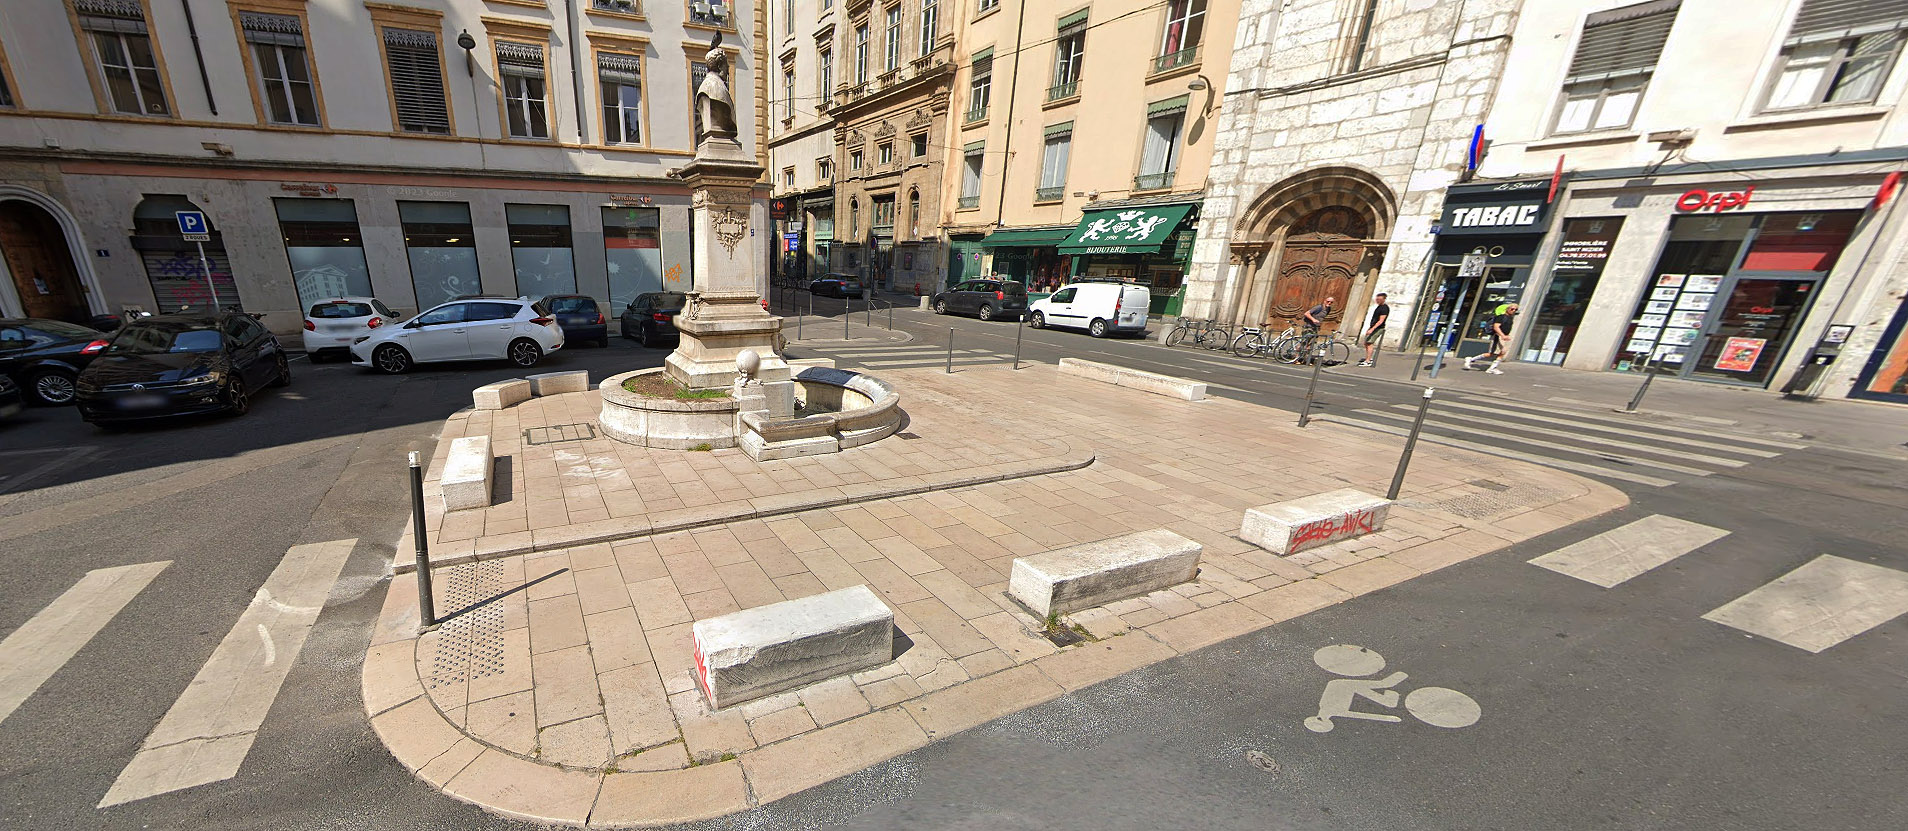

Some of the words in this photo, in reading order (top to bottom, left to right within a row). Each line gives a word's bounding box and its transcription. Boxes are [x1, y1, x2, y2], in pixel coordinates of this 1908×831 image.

[1676, 185, 1757, 213] Orpi
[184, 215, 197, 230] P
[1452, 204, 1540, 227] TABAC
[1086, 246, 1128, 254] BIJOUTERIE
[1750, 306, 1775, 314] Orpi
